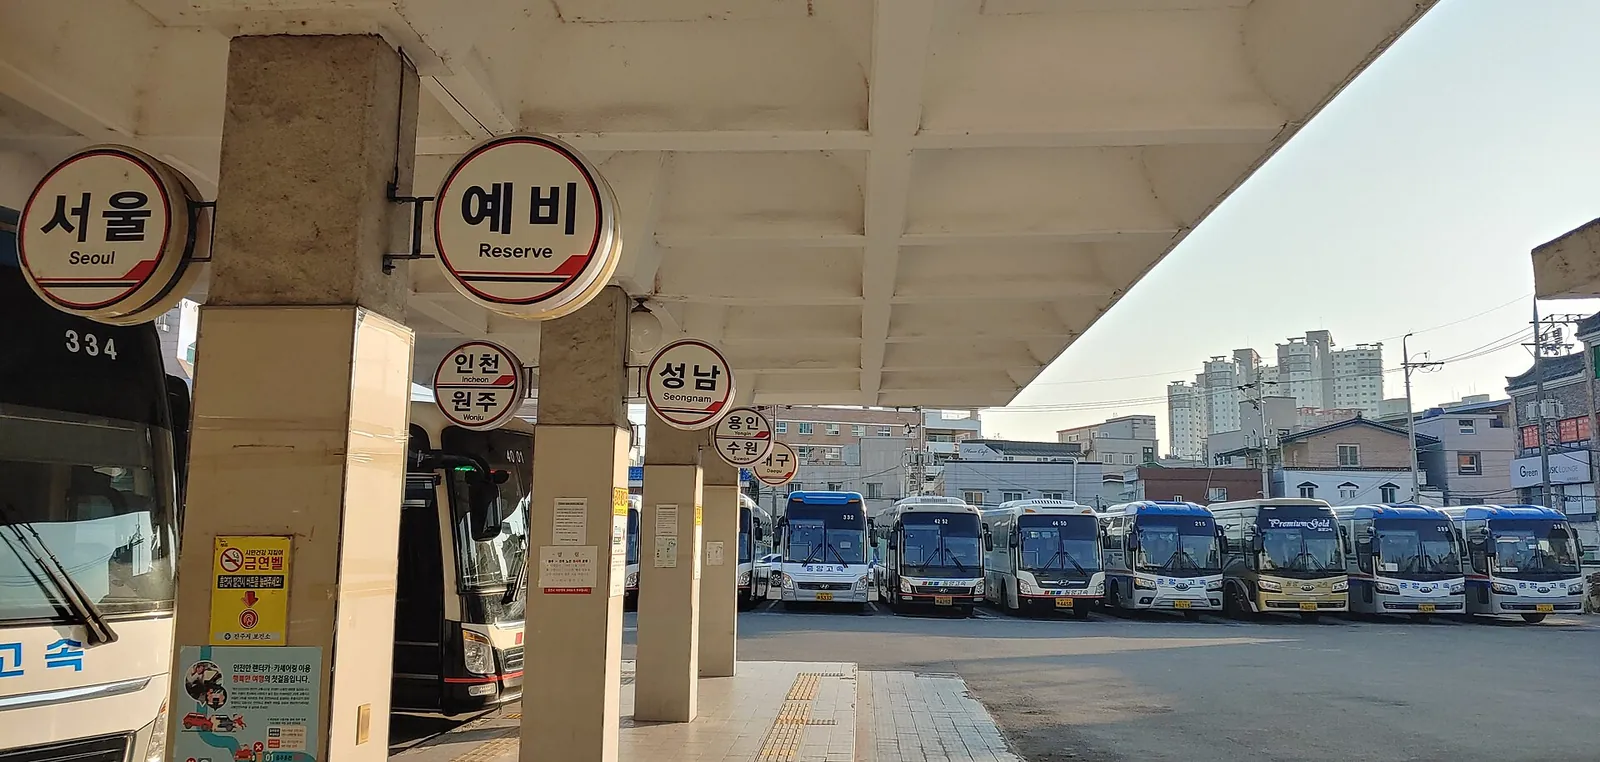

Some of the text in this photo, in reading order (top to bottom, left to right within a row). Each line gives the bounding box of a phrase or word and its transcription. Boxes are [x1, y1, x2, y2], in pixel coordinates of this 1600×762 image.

[461, 182, 577, 235] 예비
[40, 191, 152, 243] 서울
[69, 251, 115, 265] Seoul
[479, 243, 553, 258] Reserve
[65, 329, 117, 360] 334
[454, 353, 499, 374] 인천
[659, 362, 721, 391] 성남
[452, 391, 497, 412] 원주
[663, 392, 712, 403] Seongnam
[727, 415, 759, 430] 용인
[726, 441, 758, 456] 수원
[1519, 465, 1538, 478] Green
[245, 556, 283, 570] 금연벨
